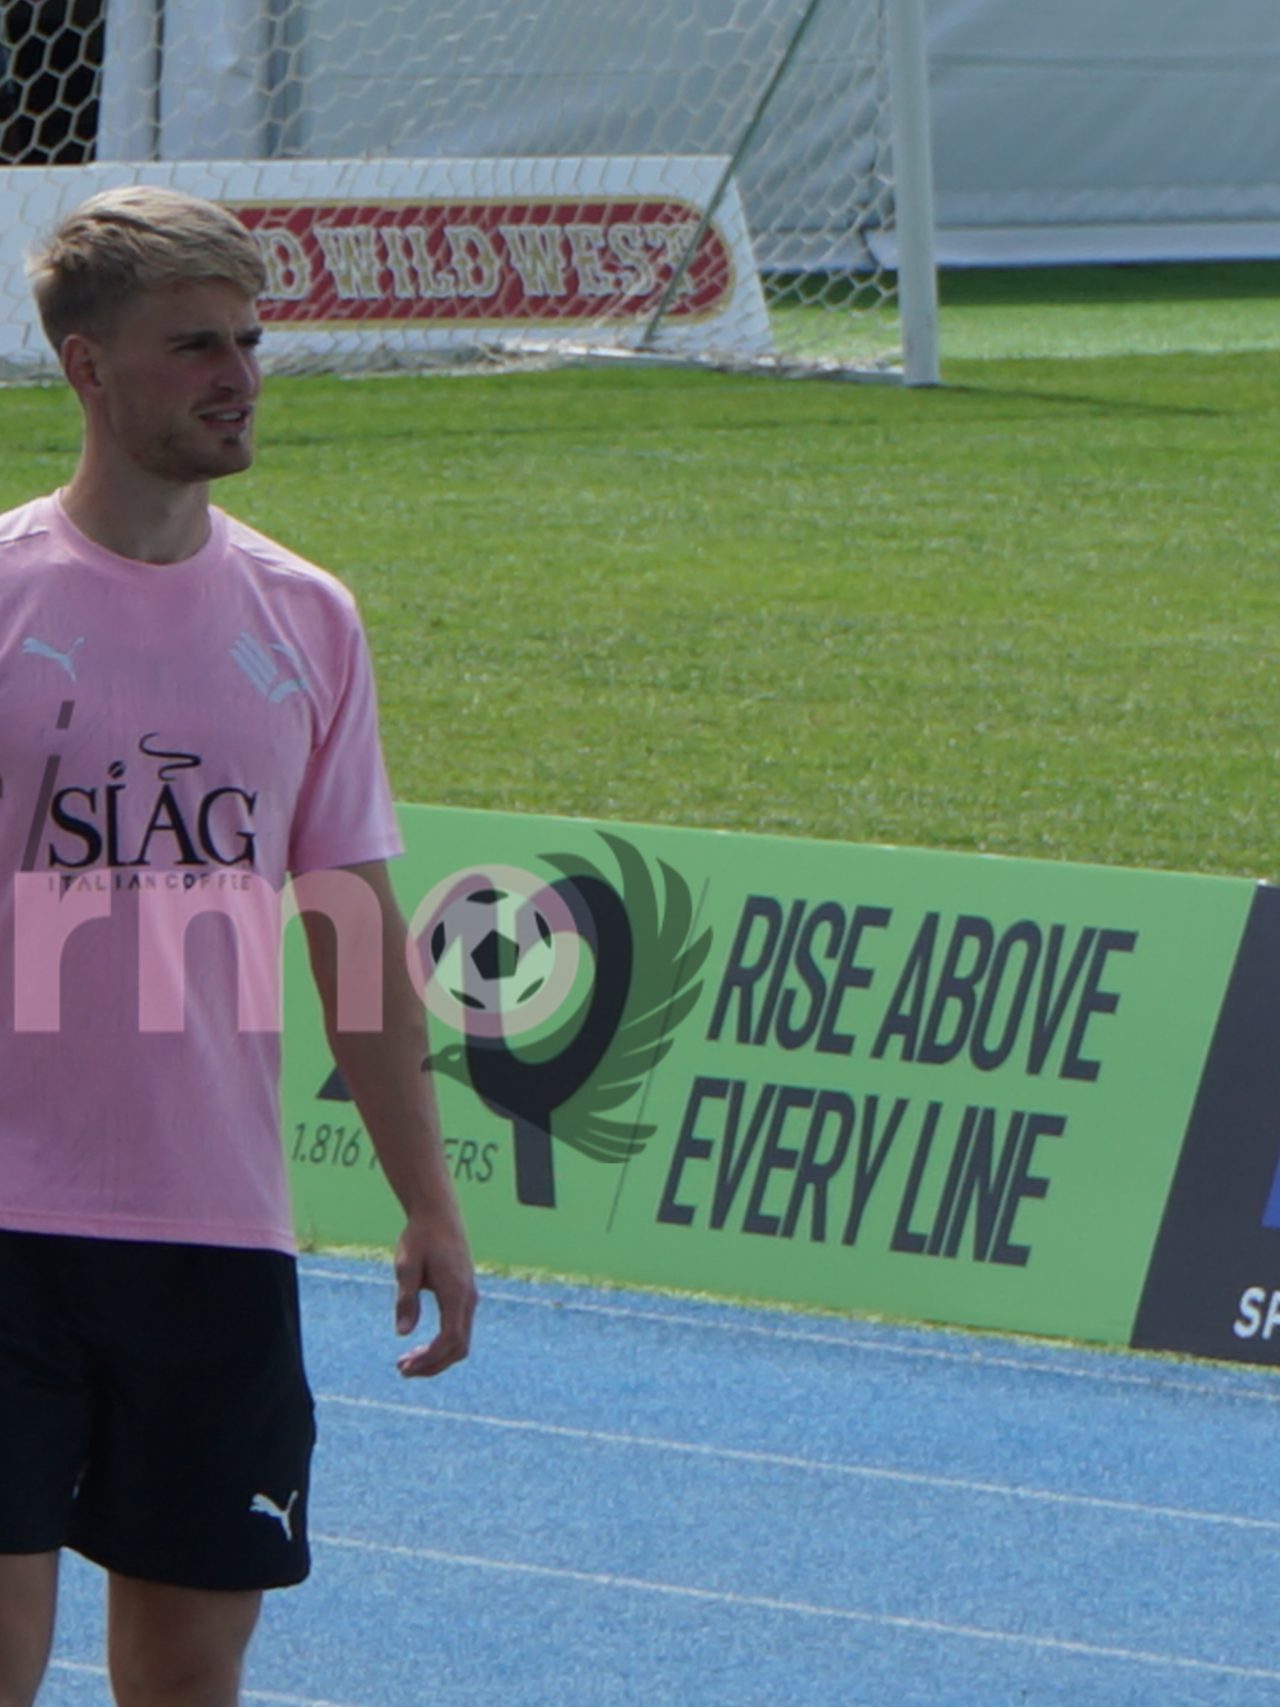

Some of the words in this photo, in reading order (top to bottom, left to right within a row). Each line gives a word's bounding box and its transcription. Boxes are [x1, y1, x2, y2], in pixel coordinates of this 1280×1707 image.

[313, 224, 504, 300] WILD
[500, 222, 702, 299] WEST
[705, 893, 894, 1056] RISE
[868, 911, 1139, 1083] ABOVE
[291, 1121, 362, 1168] 1.816
[656, 1075, 910, 1248] EVERY
[888, 1101, 1069, 1268] LINE
